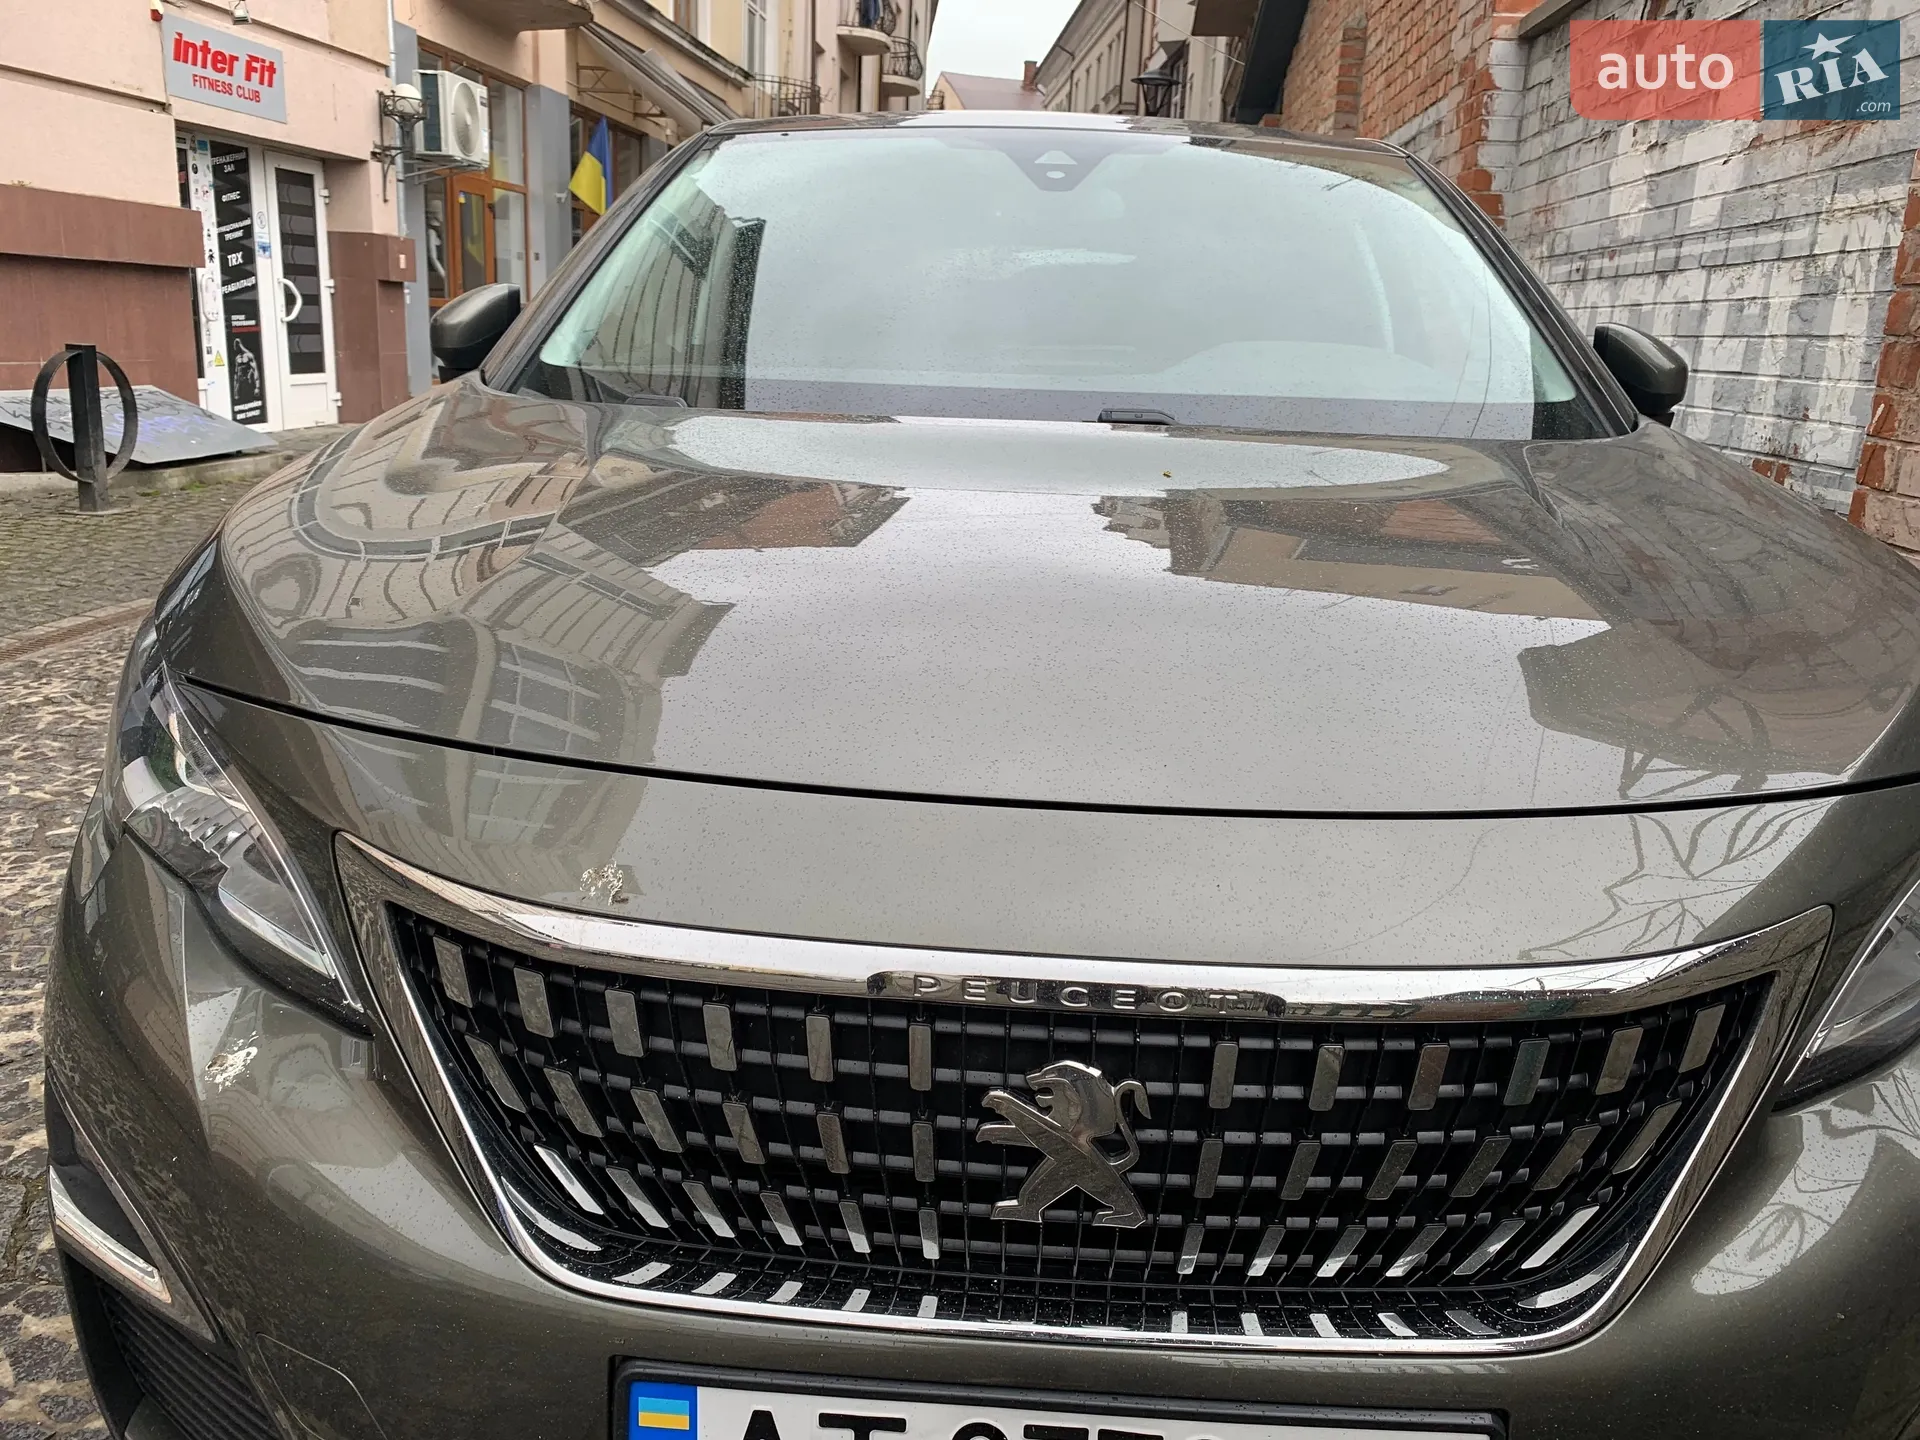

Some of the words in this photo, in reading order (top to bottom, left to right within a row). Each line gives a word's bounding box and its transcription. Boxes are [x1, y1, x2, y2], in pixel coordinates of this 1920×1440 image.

[244, 53, 276, 88] Fit
[192, 73, 233, 96] FITNESS
[236, 85, 261, 103] CLUB
[223, 163, 235, 173] ЗАЛ
[227, 251, 244, 267] TRX
[913, 975, 1241, 1014] PEUGEOT
